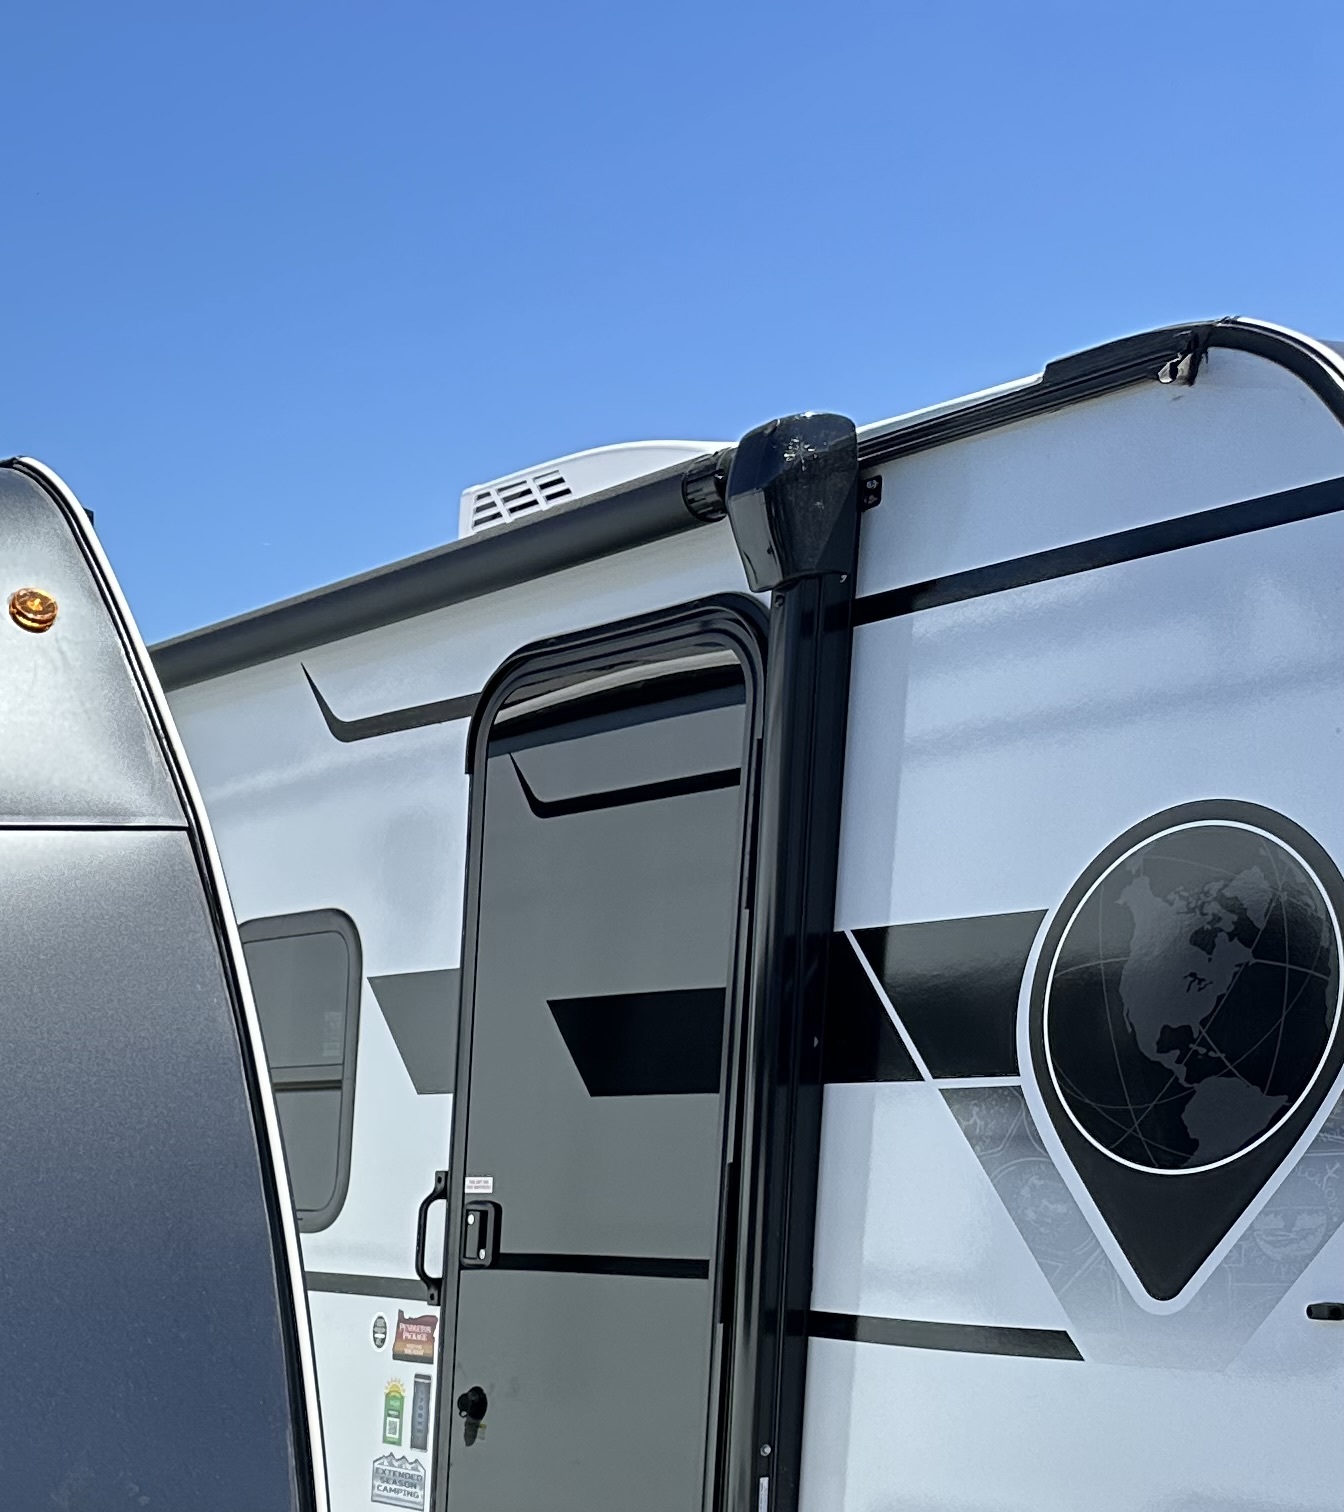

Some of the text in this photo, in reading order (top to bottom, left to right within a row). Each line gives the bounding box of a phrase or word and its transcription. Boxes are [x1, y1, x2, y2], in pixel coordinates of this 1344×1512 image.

[375, 1467, 423, 1482] EXTENDED
[379, 1475, 417, 1490] SEASON
[376, 1484, 420, 1499] CAMPING
